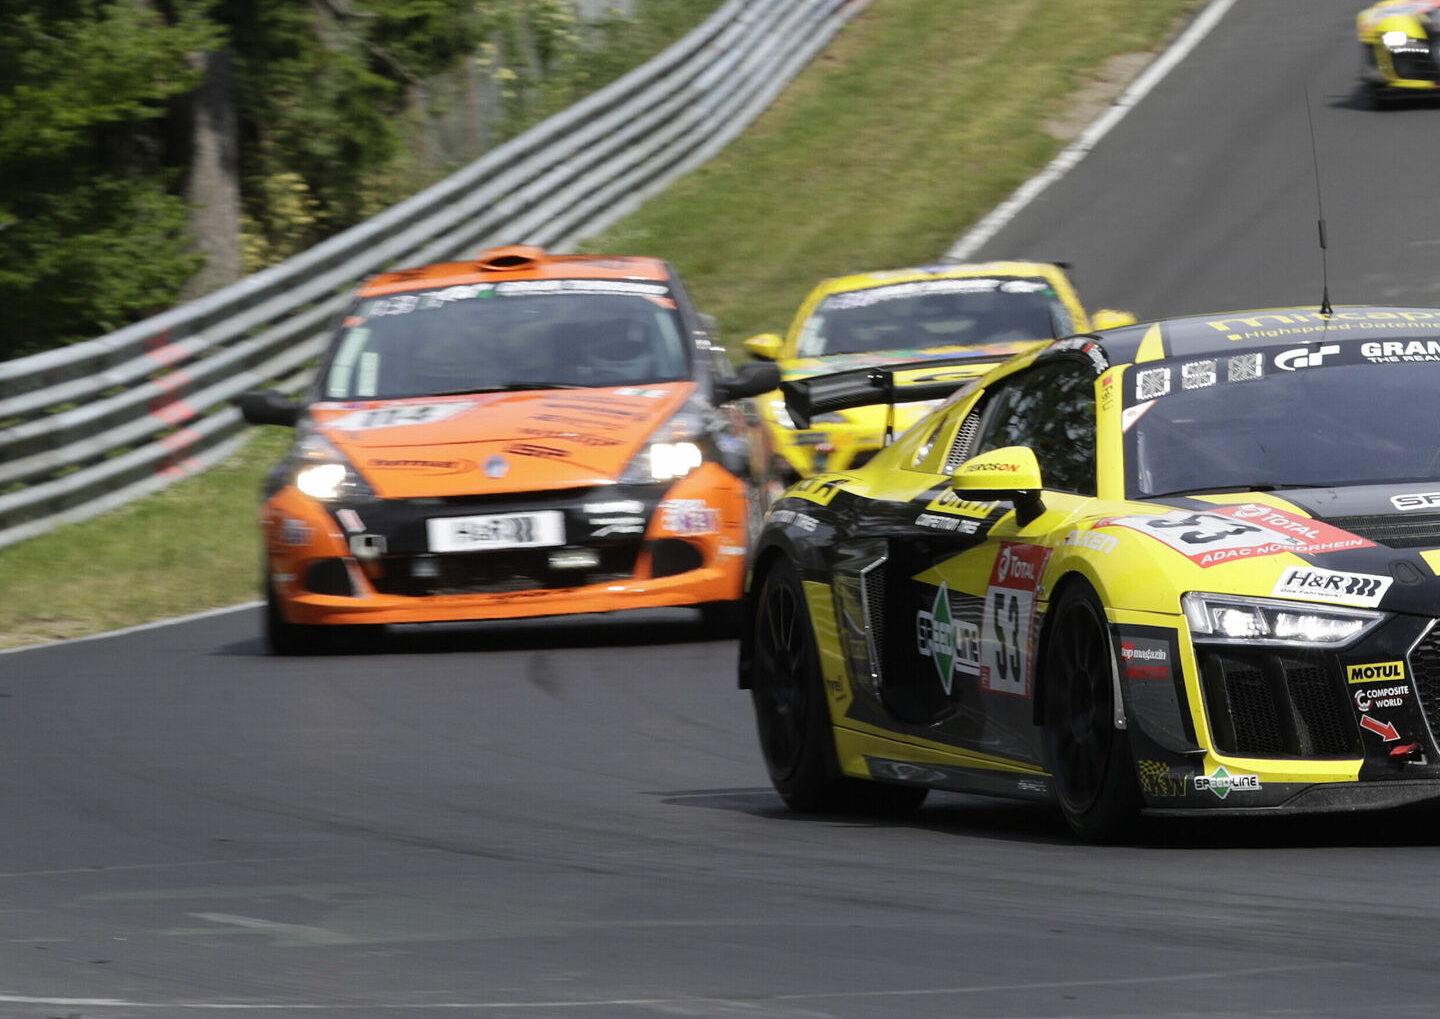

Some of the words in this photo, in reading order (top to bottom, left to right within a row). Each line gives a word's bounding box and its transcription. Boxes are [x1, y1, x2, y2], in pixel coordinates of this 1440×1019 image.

[1367, 355, 1400, 363] THE
[1261, 513, 1321, 540] TOTAL
[1200, 548, 1251, 566] ADAC
[1255, 538, 1364, 554] NORDRHEIN
[1010, 555, 1036, 580] TOTAL
[1287, 571, 1345, 591] H&R
[993, 593, 1021, 683] 53
[1350, 665, 1401, 681] MOTUL
[1366, 685, 1410, 699] COMPOSITE
[1375, 698, 1403, 708] WORLD
